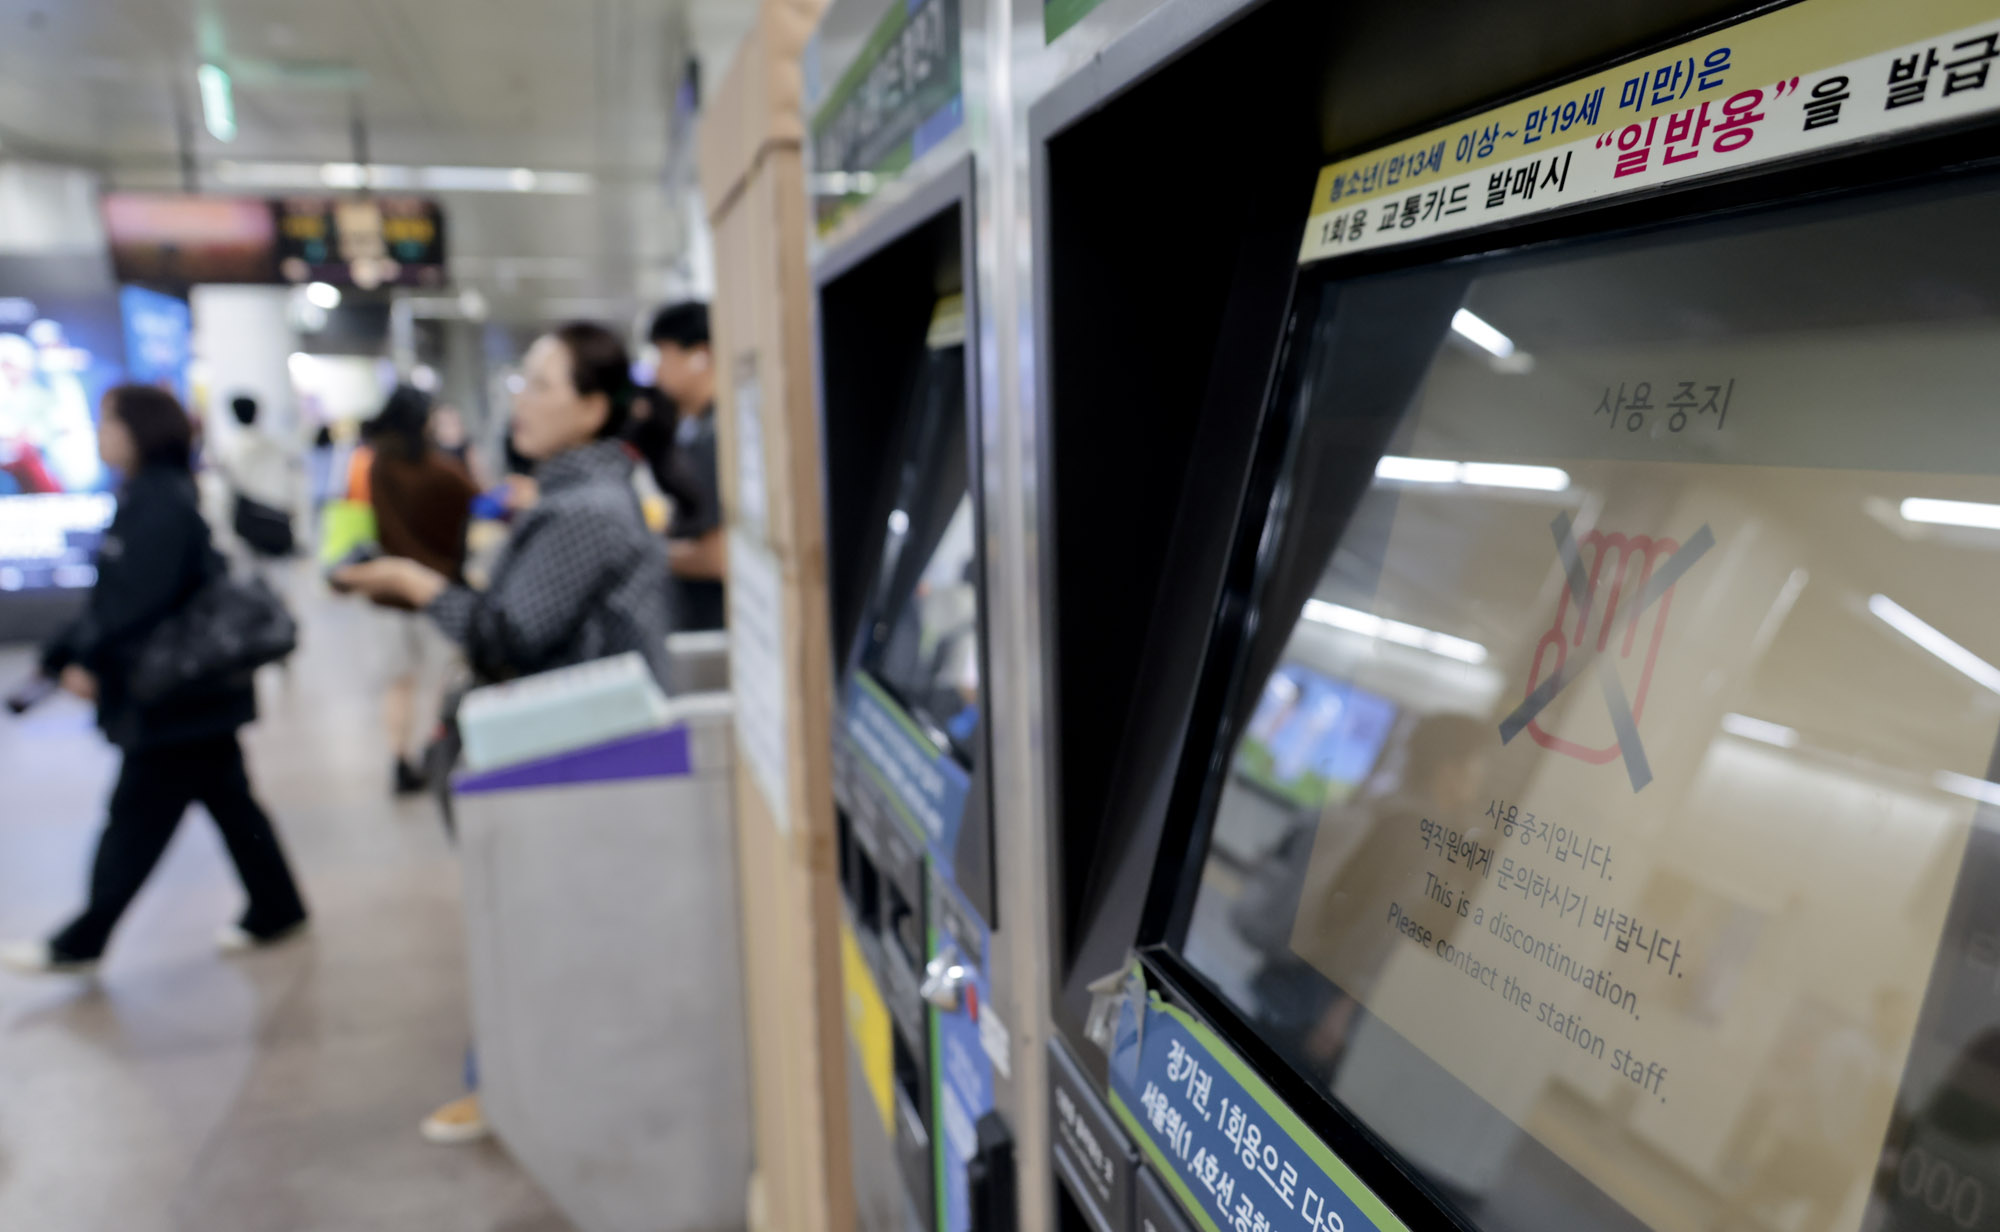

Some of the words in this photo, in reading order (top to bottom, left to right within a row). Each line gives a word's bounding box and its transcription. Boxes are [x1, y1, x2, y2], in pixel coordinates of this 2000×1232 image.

[1619, 47, 1731, 112] 미만)은
[1321, 208, 1367, 245] 1회용
[1377, 183, 1470, 233] 교통카드
[1485, 150, 1573, 209] 발매시
[1593, 381, 1654, 432] 사용
[1666, 377, 1735, 432] 중지
[1485, 800, 1612, 881] 사용중지입니다.
[1420, 818, 1494, 879] 역직원에게
[1497, 857, 1588, 928] 문의하시기
[1593, 905, 1683, 979] 바랍니다.
[1425, 871, 1453, 908] This
[1457, 890, 1470, 918] is
[1474, 907, 1484, 926] a
[1489, 911, 1640, 1021] discontinuation.
[1387, 902, 1432, 949] Please
[1436, 939, 1498, 991] contact
[1502, 975, 1532, 1013] the
[1536, 1002, 1606, 1060] station
[1611, 1049, 1668, 1104] staff.
[1218, 1098, 1298, 1210] 1회용으로
